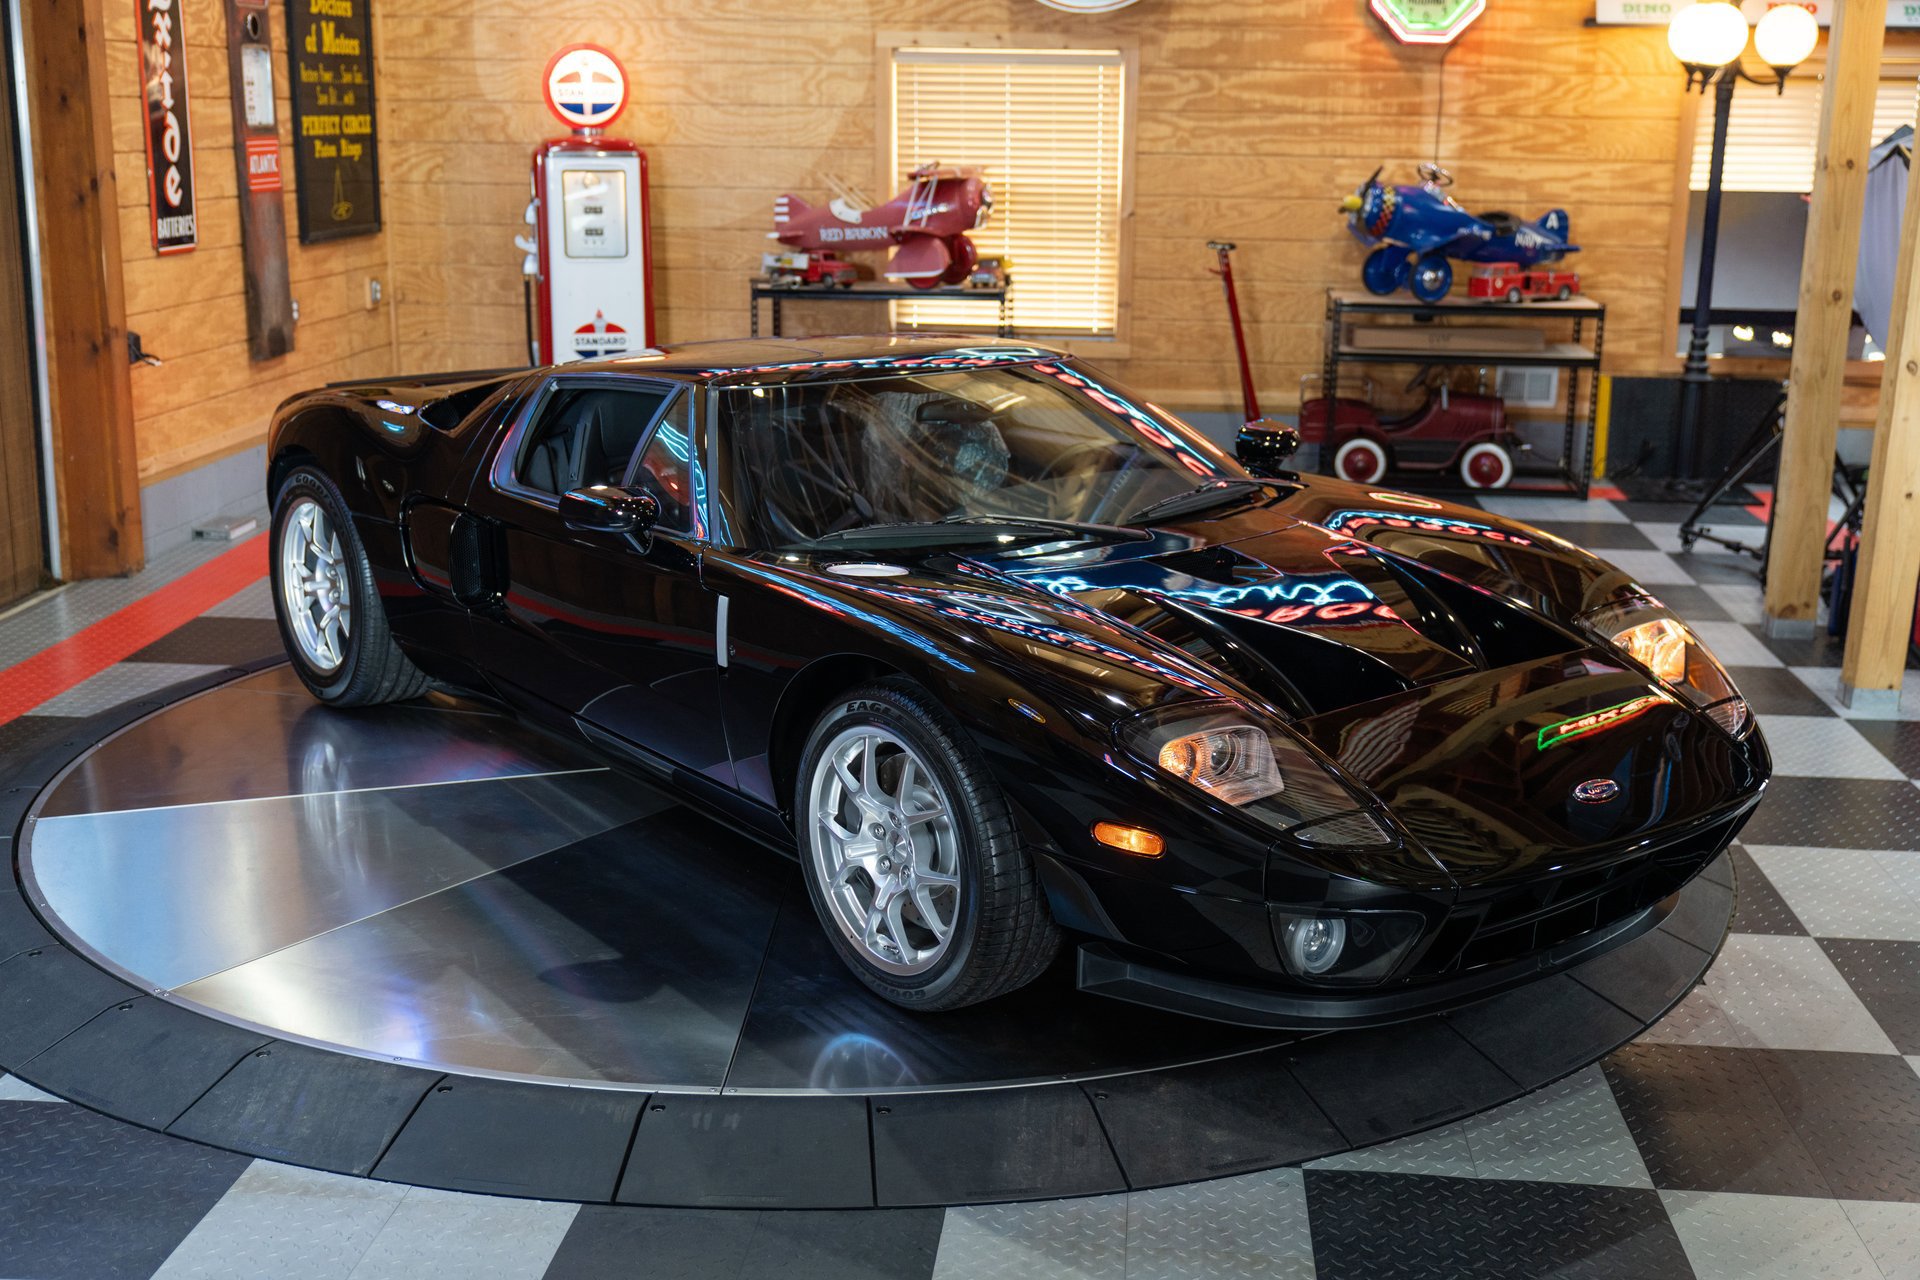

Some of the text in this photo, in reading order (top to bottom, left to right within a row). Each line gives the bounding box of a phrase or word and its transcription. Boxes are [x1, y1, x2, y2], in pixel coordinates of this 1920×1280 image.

[320, 20, 360, 55] Motors
[249, 154, 278, 174] ATLANTIC
[157, 214, 194, 239] BATTERIES
[1546, 211, 1559, 230] A
[819, 228, 843, 241] RED
[575, 336, 627, 346] STANDARD
